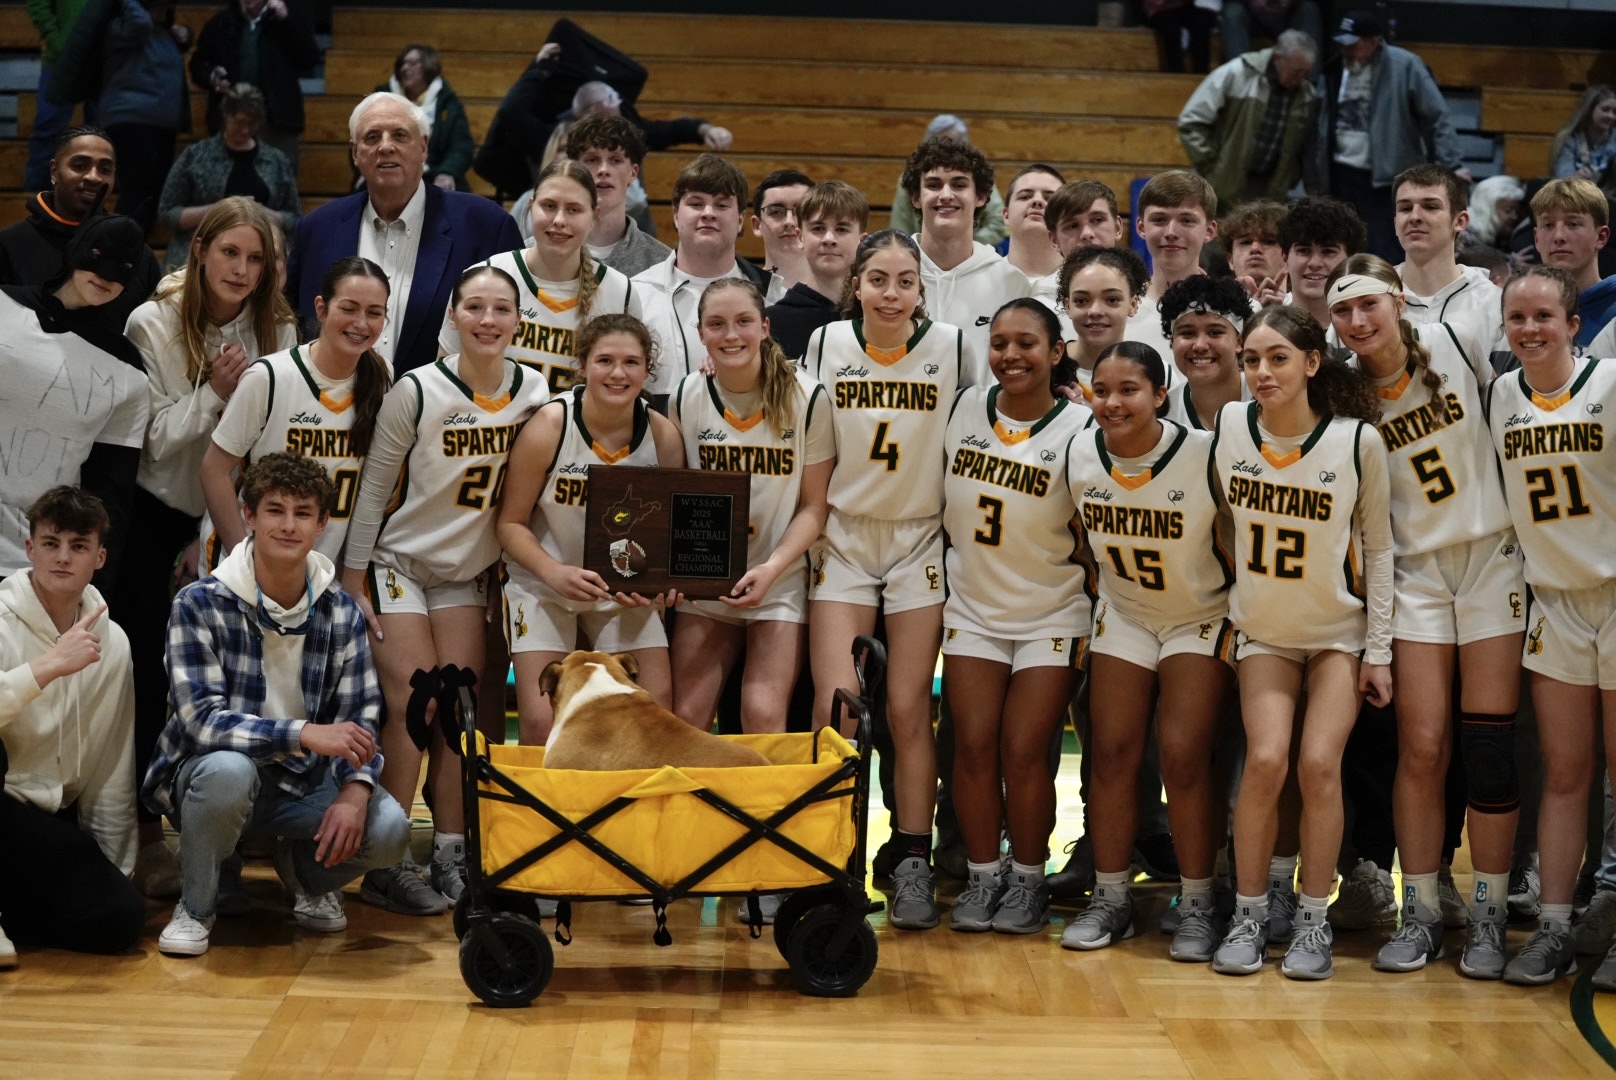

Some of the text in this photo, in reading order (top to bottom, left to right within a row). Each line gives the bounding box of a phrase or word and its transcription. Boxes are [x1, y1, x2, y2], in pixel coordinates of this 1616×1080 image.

[519, 307, 539, 319] ady
[511, 320, 577, 357] PARTA
[836, 365, 869, 377] Lady
[38, 358, 115, 418] AM
[835, 380, 938, 411] SPARTANS
[289, 411, 322, 425] Lady
[443, 413, 478, 425] Lady
[1378, 392, 1465, 453] ARTAS
[1504, 413, 1534, 427] Lady
[286, 427, 364, 457] SPARTA
[443, 421, 525, 457] SPARTA
[698, 429, 728, 442] Lady
[869, 421, 900, 472] 4
[960, 434, 991, 449] Lady
[1504, 422, 1604, 460] SPARTANS
[698, 444, 794, 476] SPARTANS
[951, 448, 1051, 498] SPARTANS
[1232, 460, 1264, 476] Lady
[1409, 444, 1458, 505] 5
[681, 497, 724, 508] WVSSAC
[1084, 486, 1114, 501] Lady
[1228, 475, 1333, 522] SPARTANS
[1524, 464, 1593, 525] 21
[692, 509, 711, 518] 2025
[974, 493, 1005, 547] 3
[1083, 502, 1184, 540] SPARTANS
[674, 529, 728, 541] BASKETBALL
[1247, 521, 1307, 580] 12
[675, 563, 724, 573] CHAMPION
[677, 553, 722, 563] REGIONAL
[1106, 545, 1167, 592] 15
